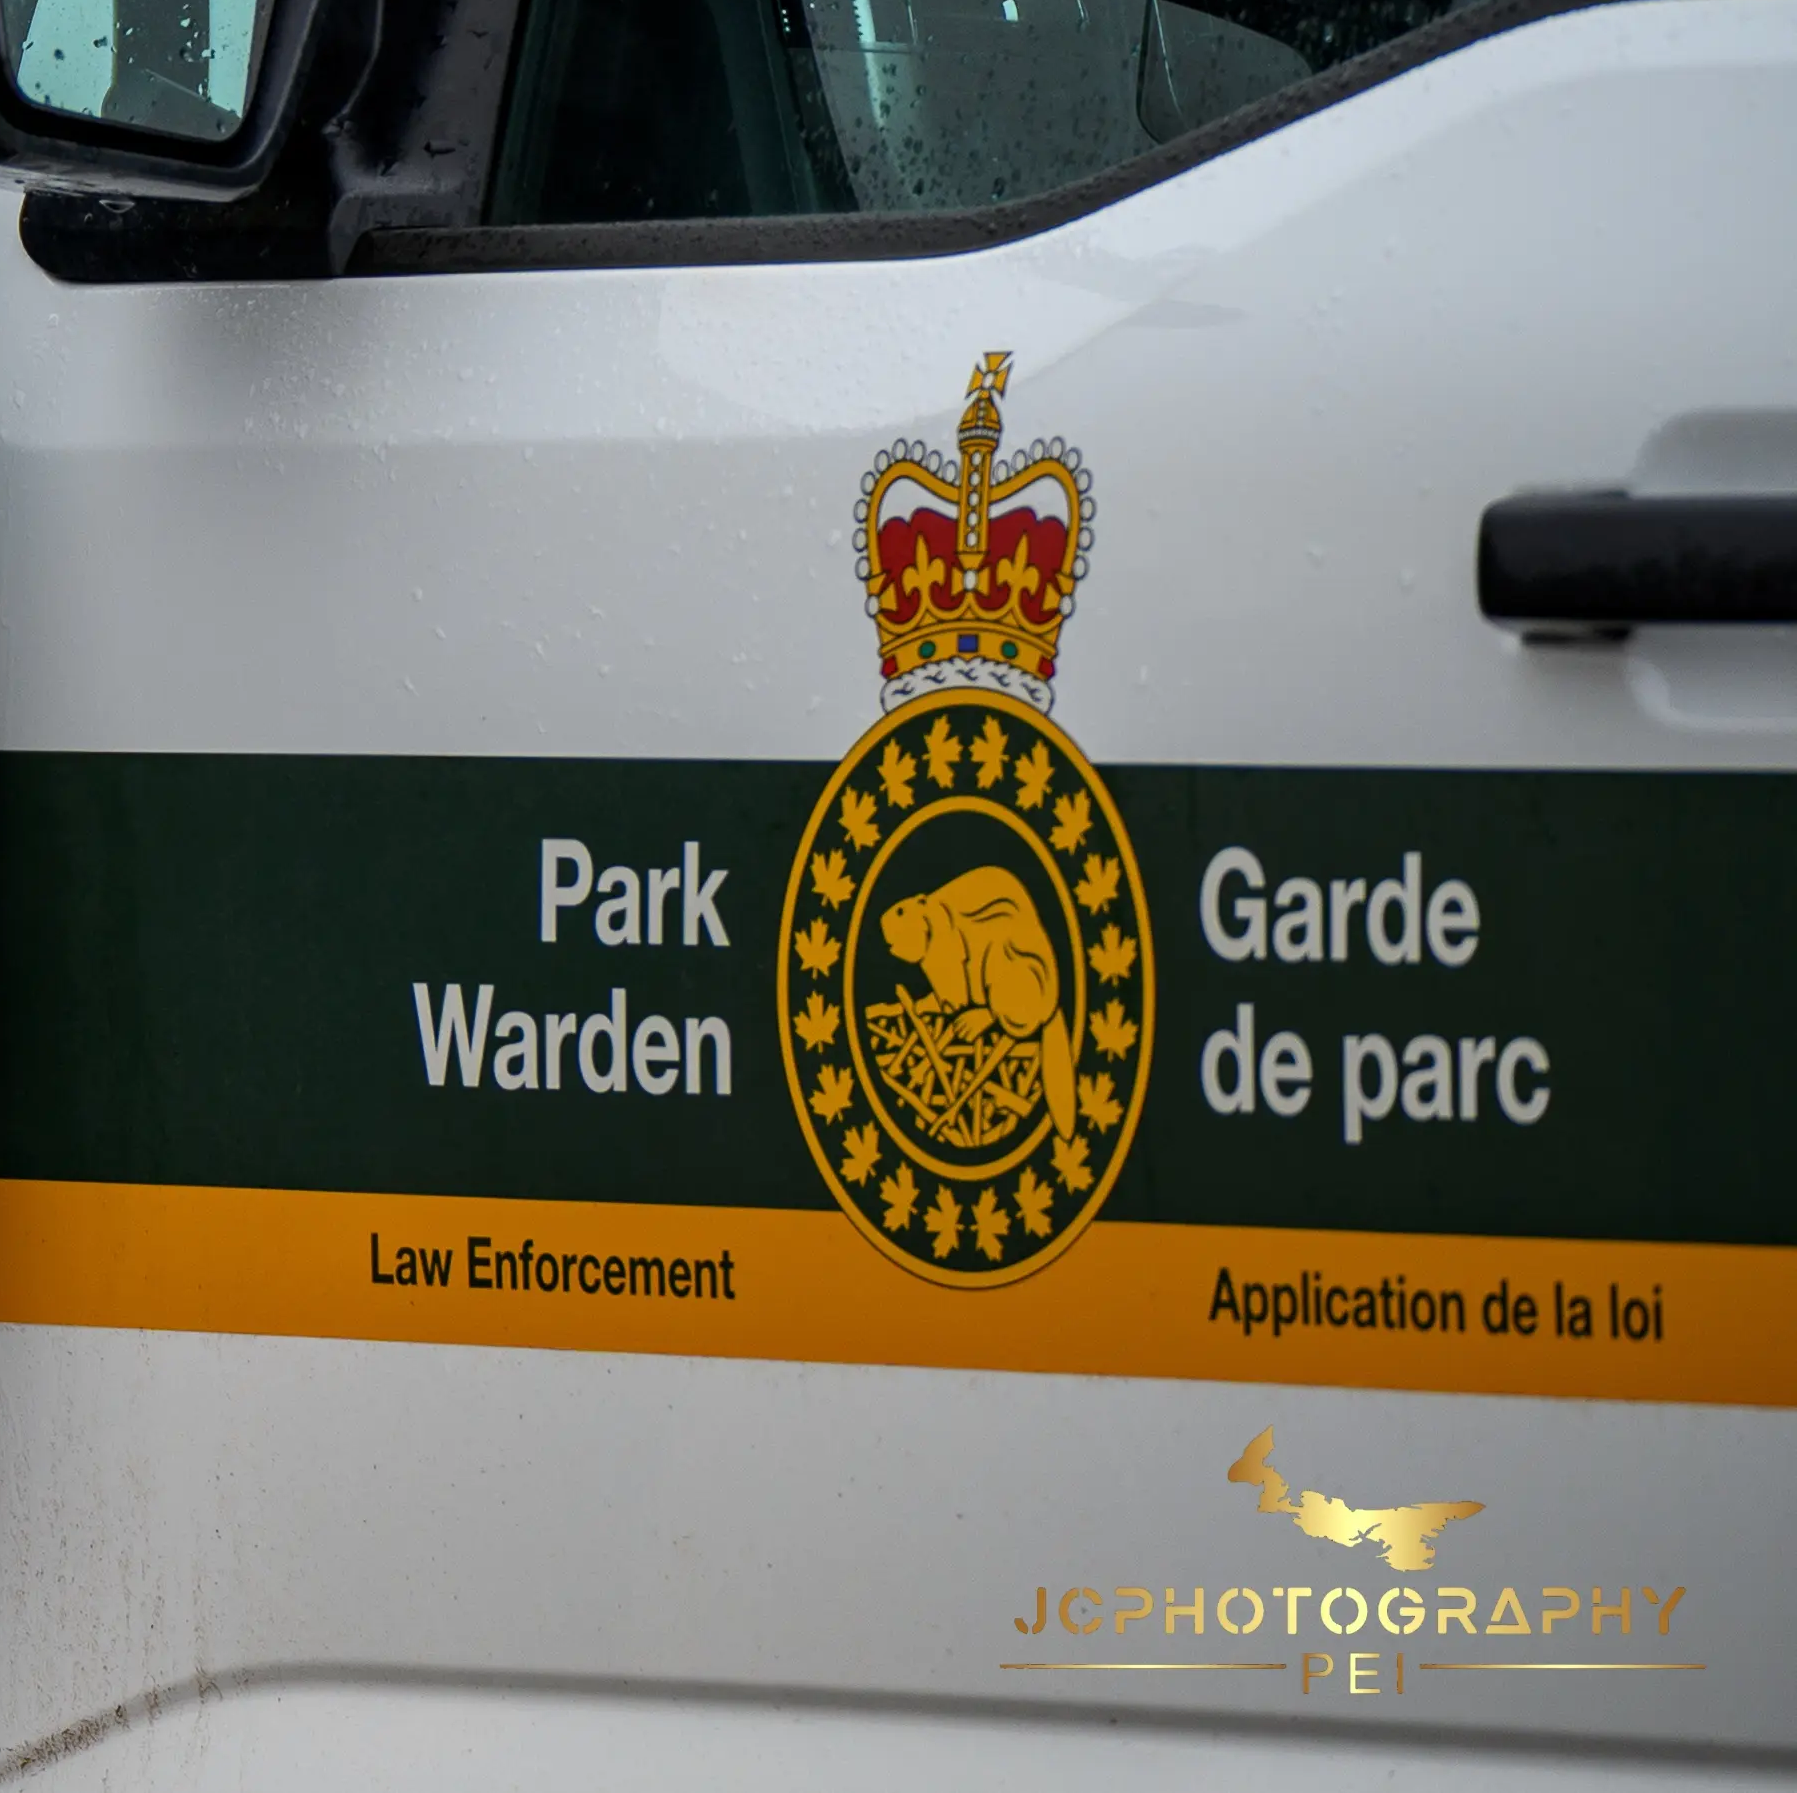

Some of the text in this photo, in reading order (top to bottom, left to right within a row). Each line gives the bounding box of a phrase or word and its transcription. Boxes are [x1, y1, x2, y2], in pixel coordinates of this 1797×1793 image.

[540, 838, 731, 947] Park
[1199, 846, 1481, 967] Garde
[412, 982, 732, 1095] Warden
[1201, 1003, 1551, 1145] de parc
[370, 1232, 736, 1300] Law Enforcement
[1209, 1267, 1665, 1342] Application de la loi
